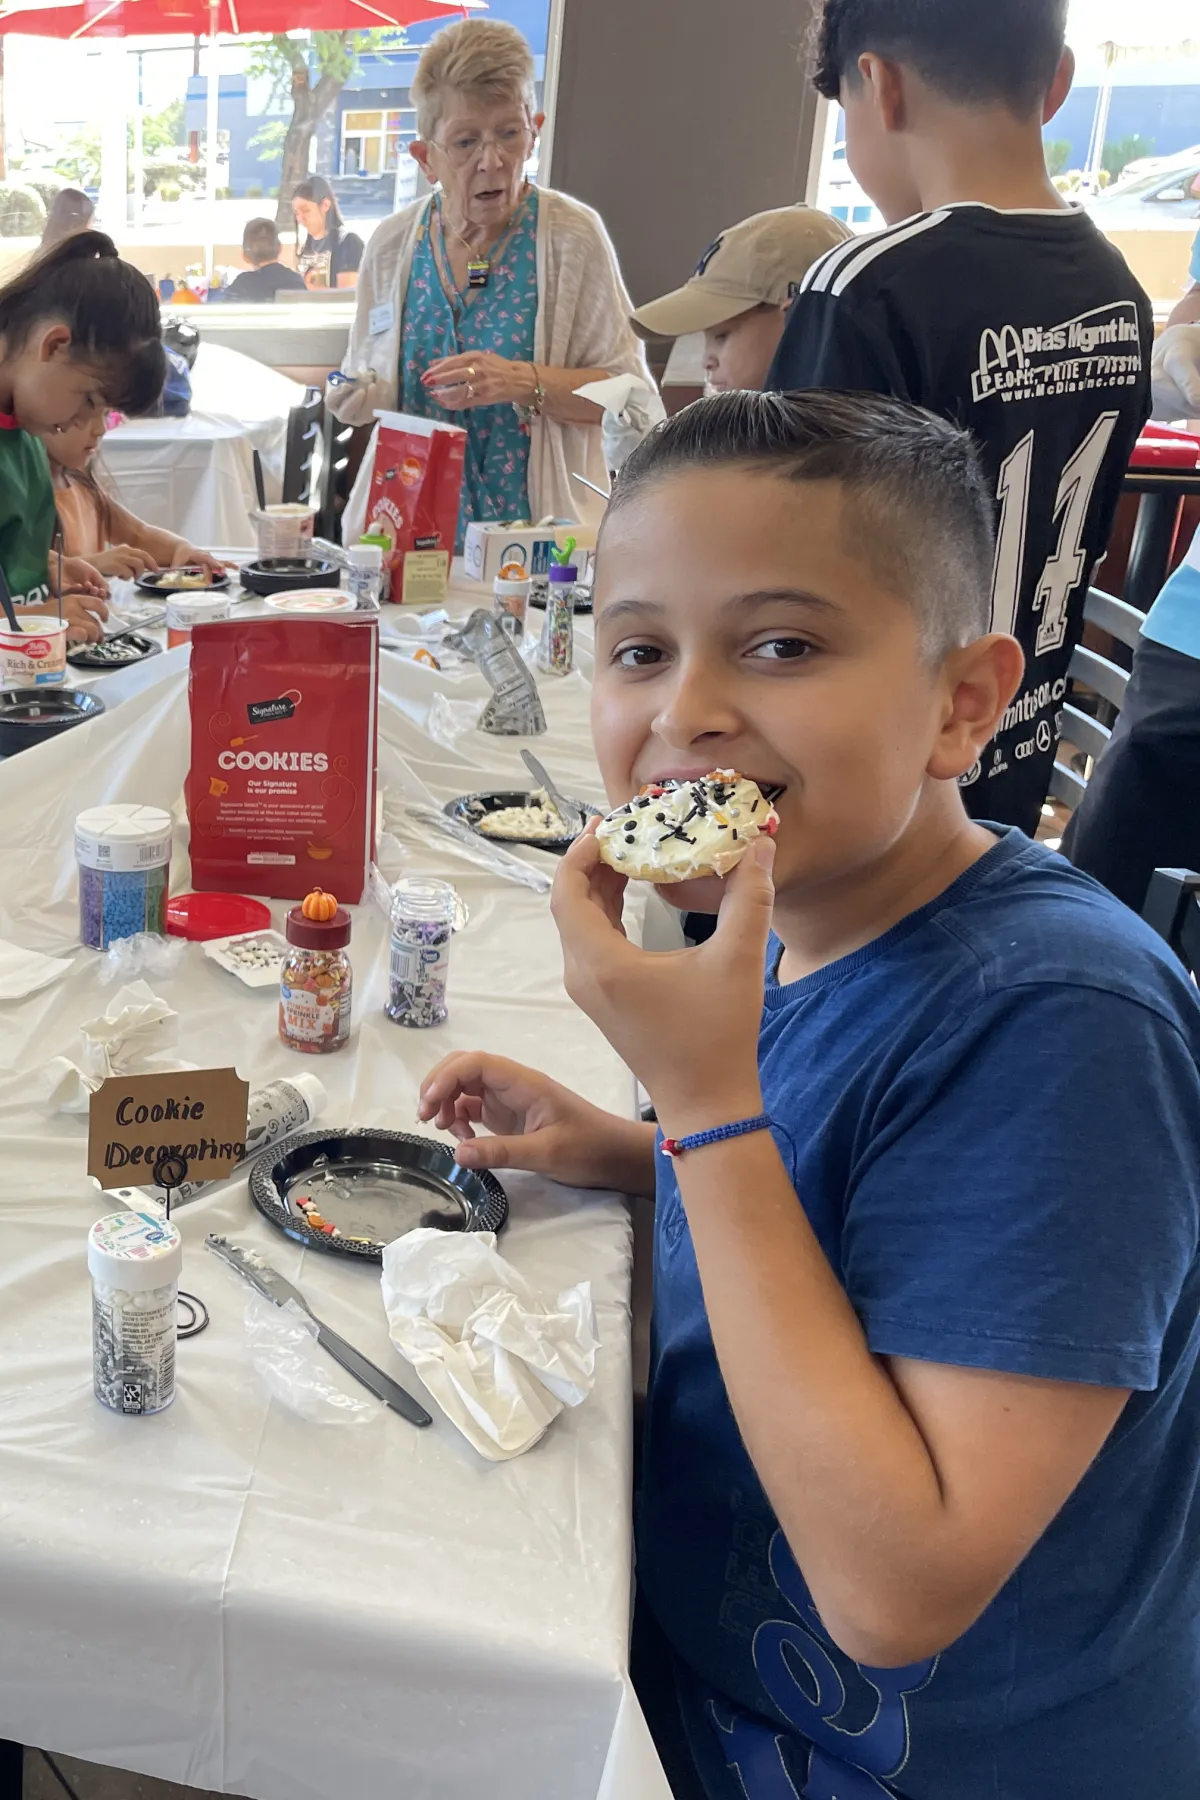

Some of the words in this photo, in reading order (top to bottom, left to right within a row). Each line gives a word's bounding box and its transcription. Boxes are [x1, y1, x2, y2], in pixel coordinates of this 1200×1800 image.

[1022, 326, 1067, 353] Dias
[987, 410, 1120, 657] 14
[7, 658, 27, 669] Rich
[28, 660, 35, 669] &
[218, 751, 329, 772] COOKIES
[263, 780, 297, 789] Signature
[287, 1006, 320, 1020] SPRINKLE
[288, 1015, 317, 1030] MIX
[116, 1096, 205, 1126] Cookie
[105, 1138, 247, 1169] Decorating
